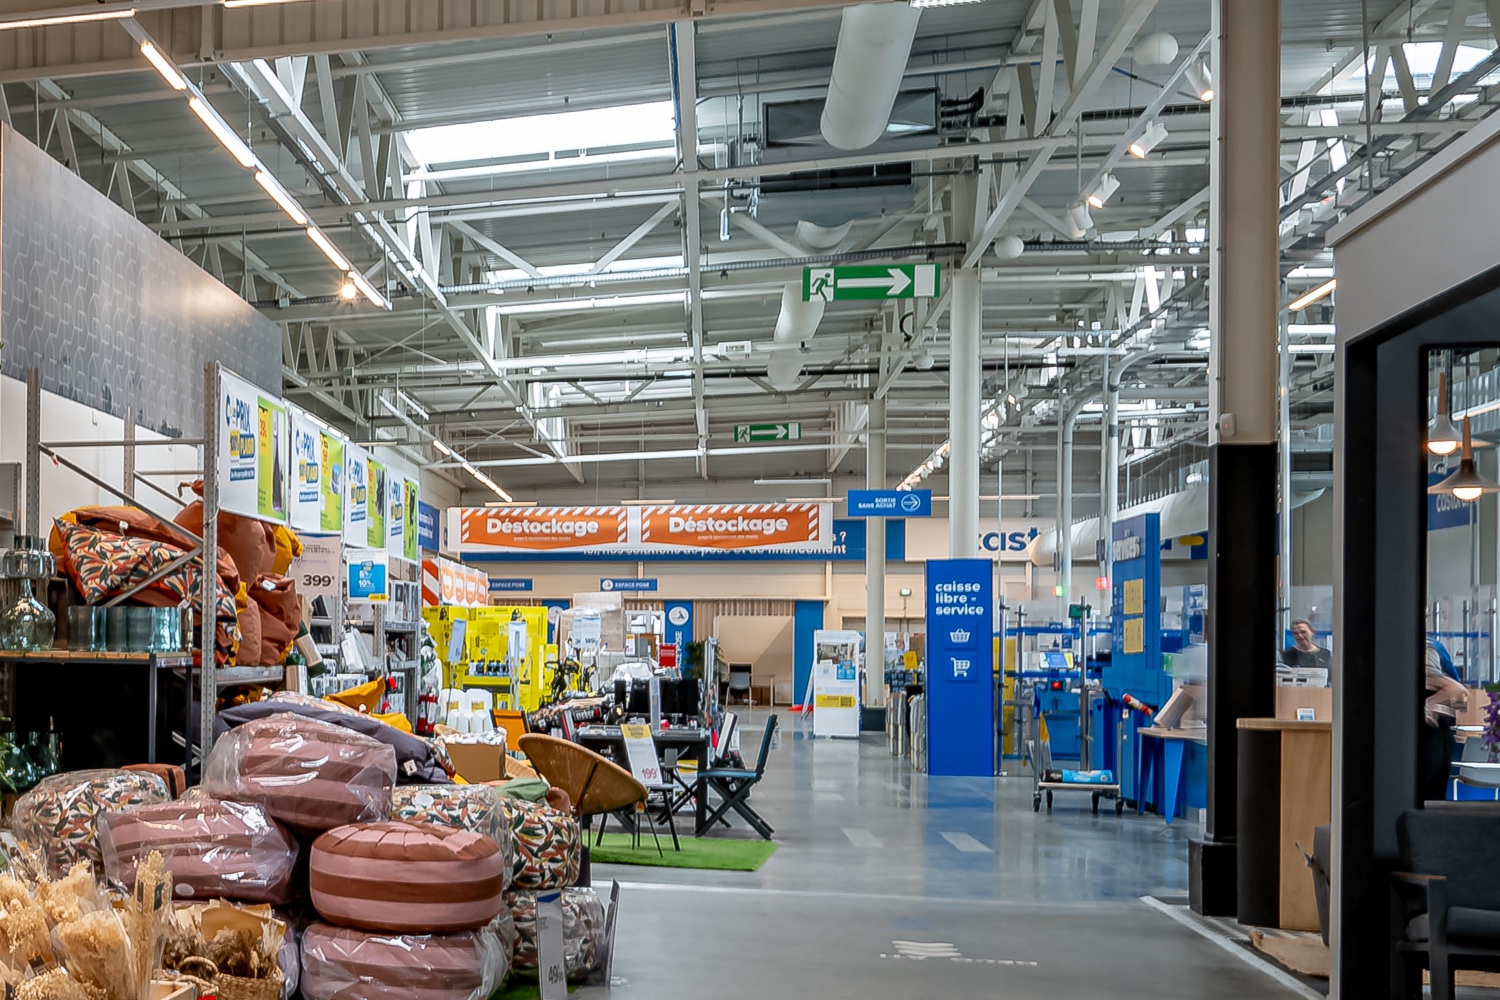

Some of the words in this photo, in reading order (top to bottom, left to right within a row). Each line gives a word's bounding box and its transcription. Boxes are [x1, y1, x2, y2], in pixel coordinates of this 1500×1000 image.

[486, 518, 599, 537] Déstockage
[668, 515, 788, 536] Déstockage
[935, 580, 981, 592] caisse
[935, 593, 968, 604] libre
[935, 605, 984, 616] service
